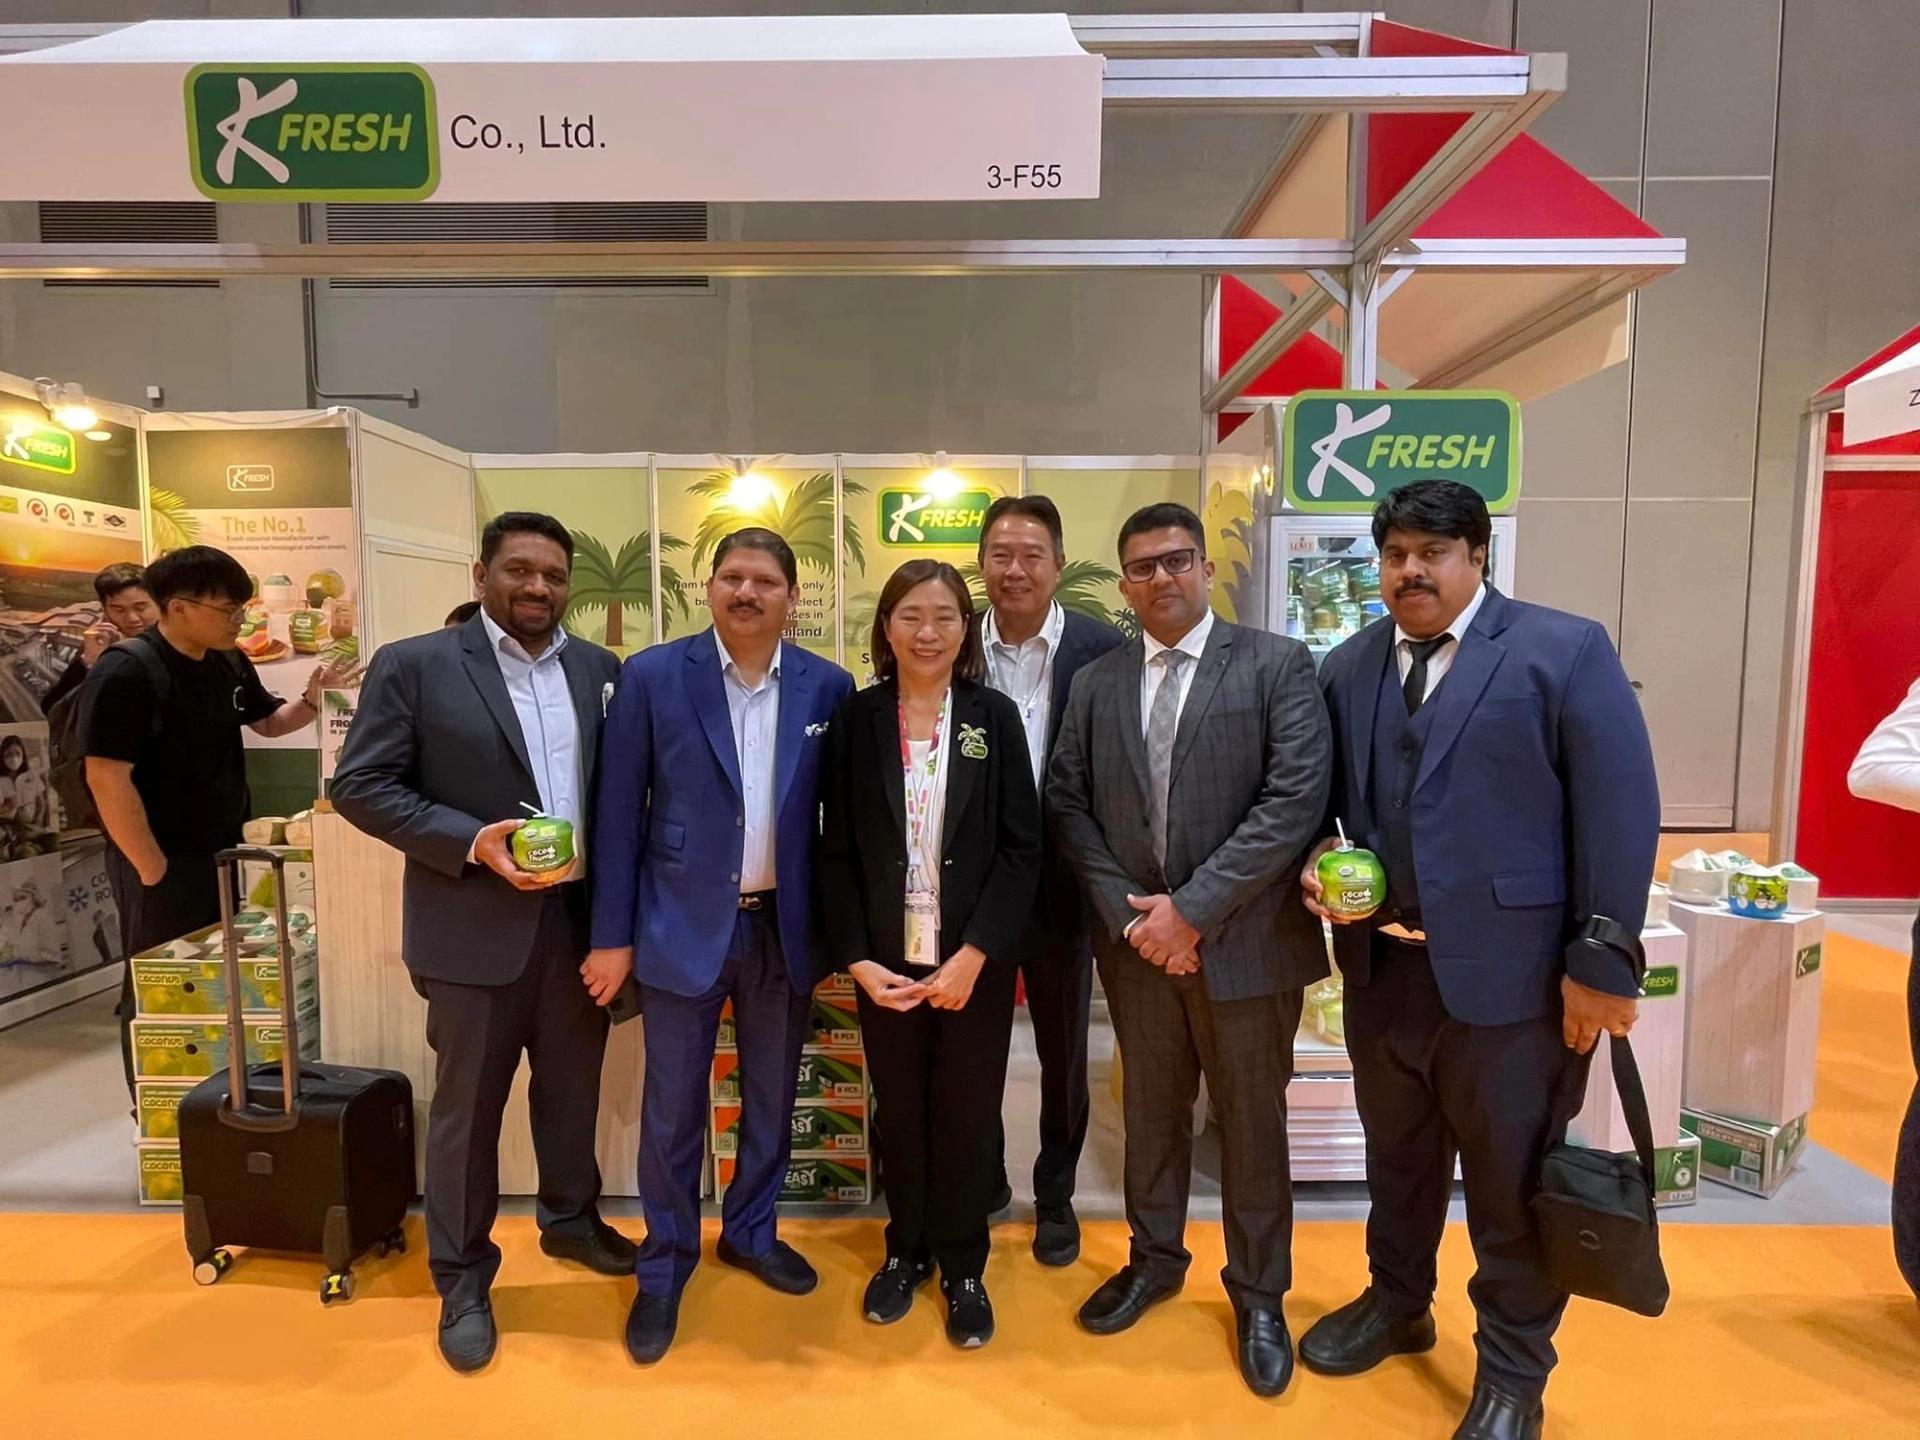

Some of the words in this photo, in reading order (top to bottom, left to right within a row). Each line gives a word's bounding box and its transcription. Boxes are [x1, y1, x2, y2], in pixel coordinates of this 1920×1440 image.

[216, 77, 298, 184] K
[278, 113, 413, 152] FRESH
[450, 114, 525, 154] Co.,
[540, 115, 606, 149] Ltd.
[987, 164, 1062, 188] 3-F55
[1307, 403, 1391, 497] K
[1366, 434, 1496, 469] FRESH
[221, 516, 257, 533] The
[263, 516, 307, 533] No.1
[889, 493, 932, 542] K
[918, 509, 984, 527] FRESH
[802, 581, 824, 591] only
[796, 598, 822, 606] elect
[814, 611, 823, 619] in
[1643, 976, 1674, 988] FRESH
[784, 1168, 817, 1185] EASY
